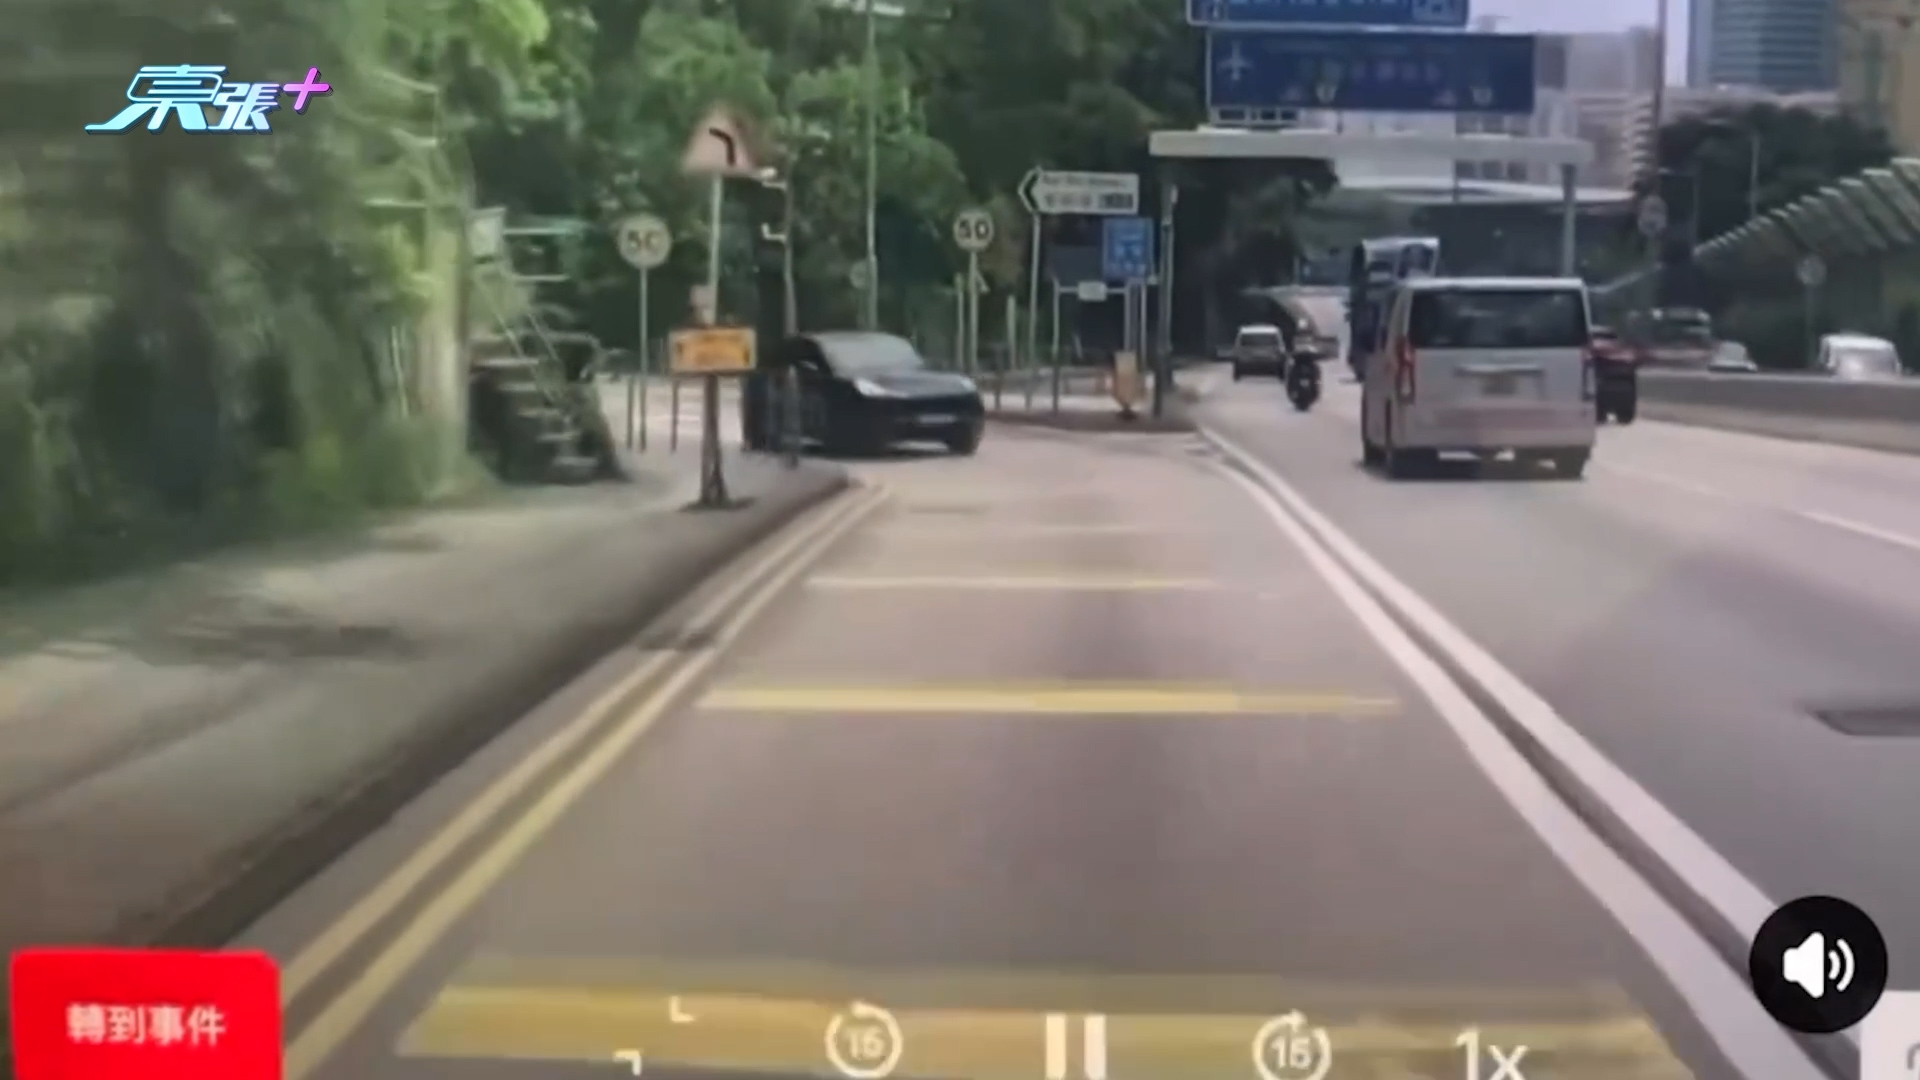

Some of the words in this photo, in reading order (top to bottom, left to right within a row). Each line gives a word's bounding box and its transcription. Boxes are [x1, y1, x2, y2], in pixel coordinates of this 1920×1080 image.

[959, 219, 990, 240] 50
[66, 1003, 226, 1046] 轉到事件
